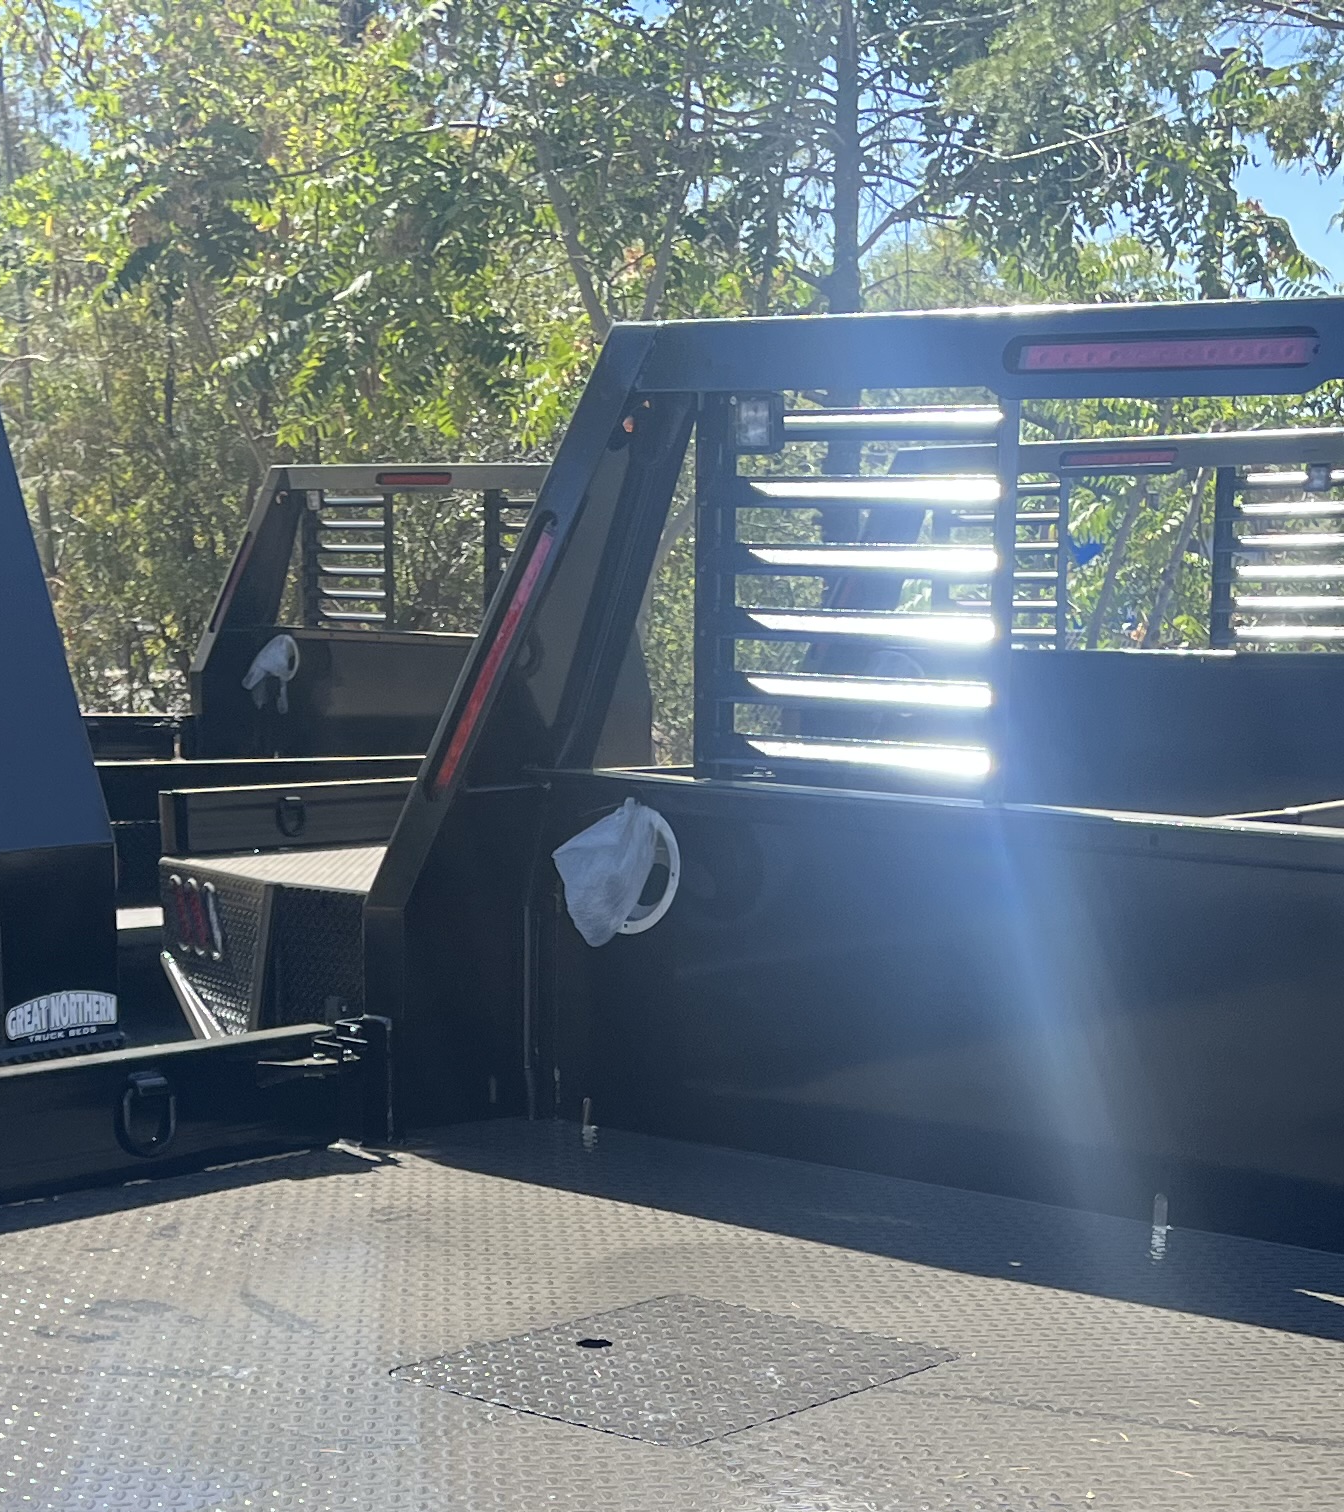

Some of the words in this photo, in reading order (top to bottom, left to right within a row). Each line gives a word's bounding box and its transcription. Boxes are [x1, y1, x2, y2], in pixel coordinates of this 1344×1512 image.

[8, 998, 48, 1037] GREAT
[50, 993, 116, 1028] NORTHERN
[28, 1032, 65, 1043] TRUCK
[69, 1026, 97, 1037] BEDS
